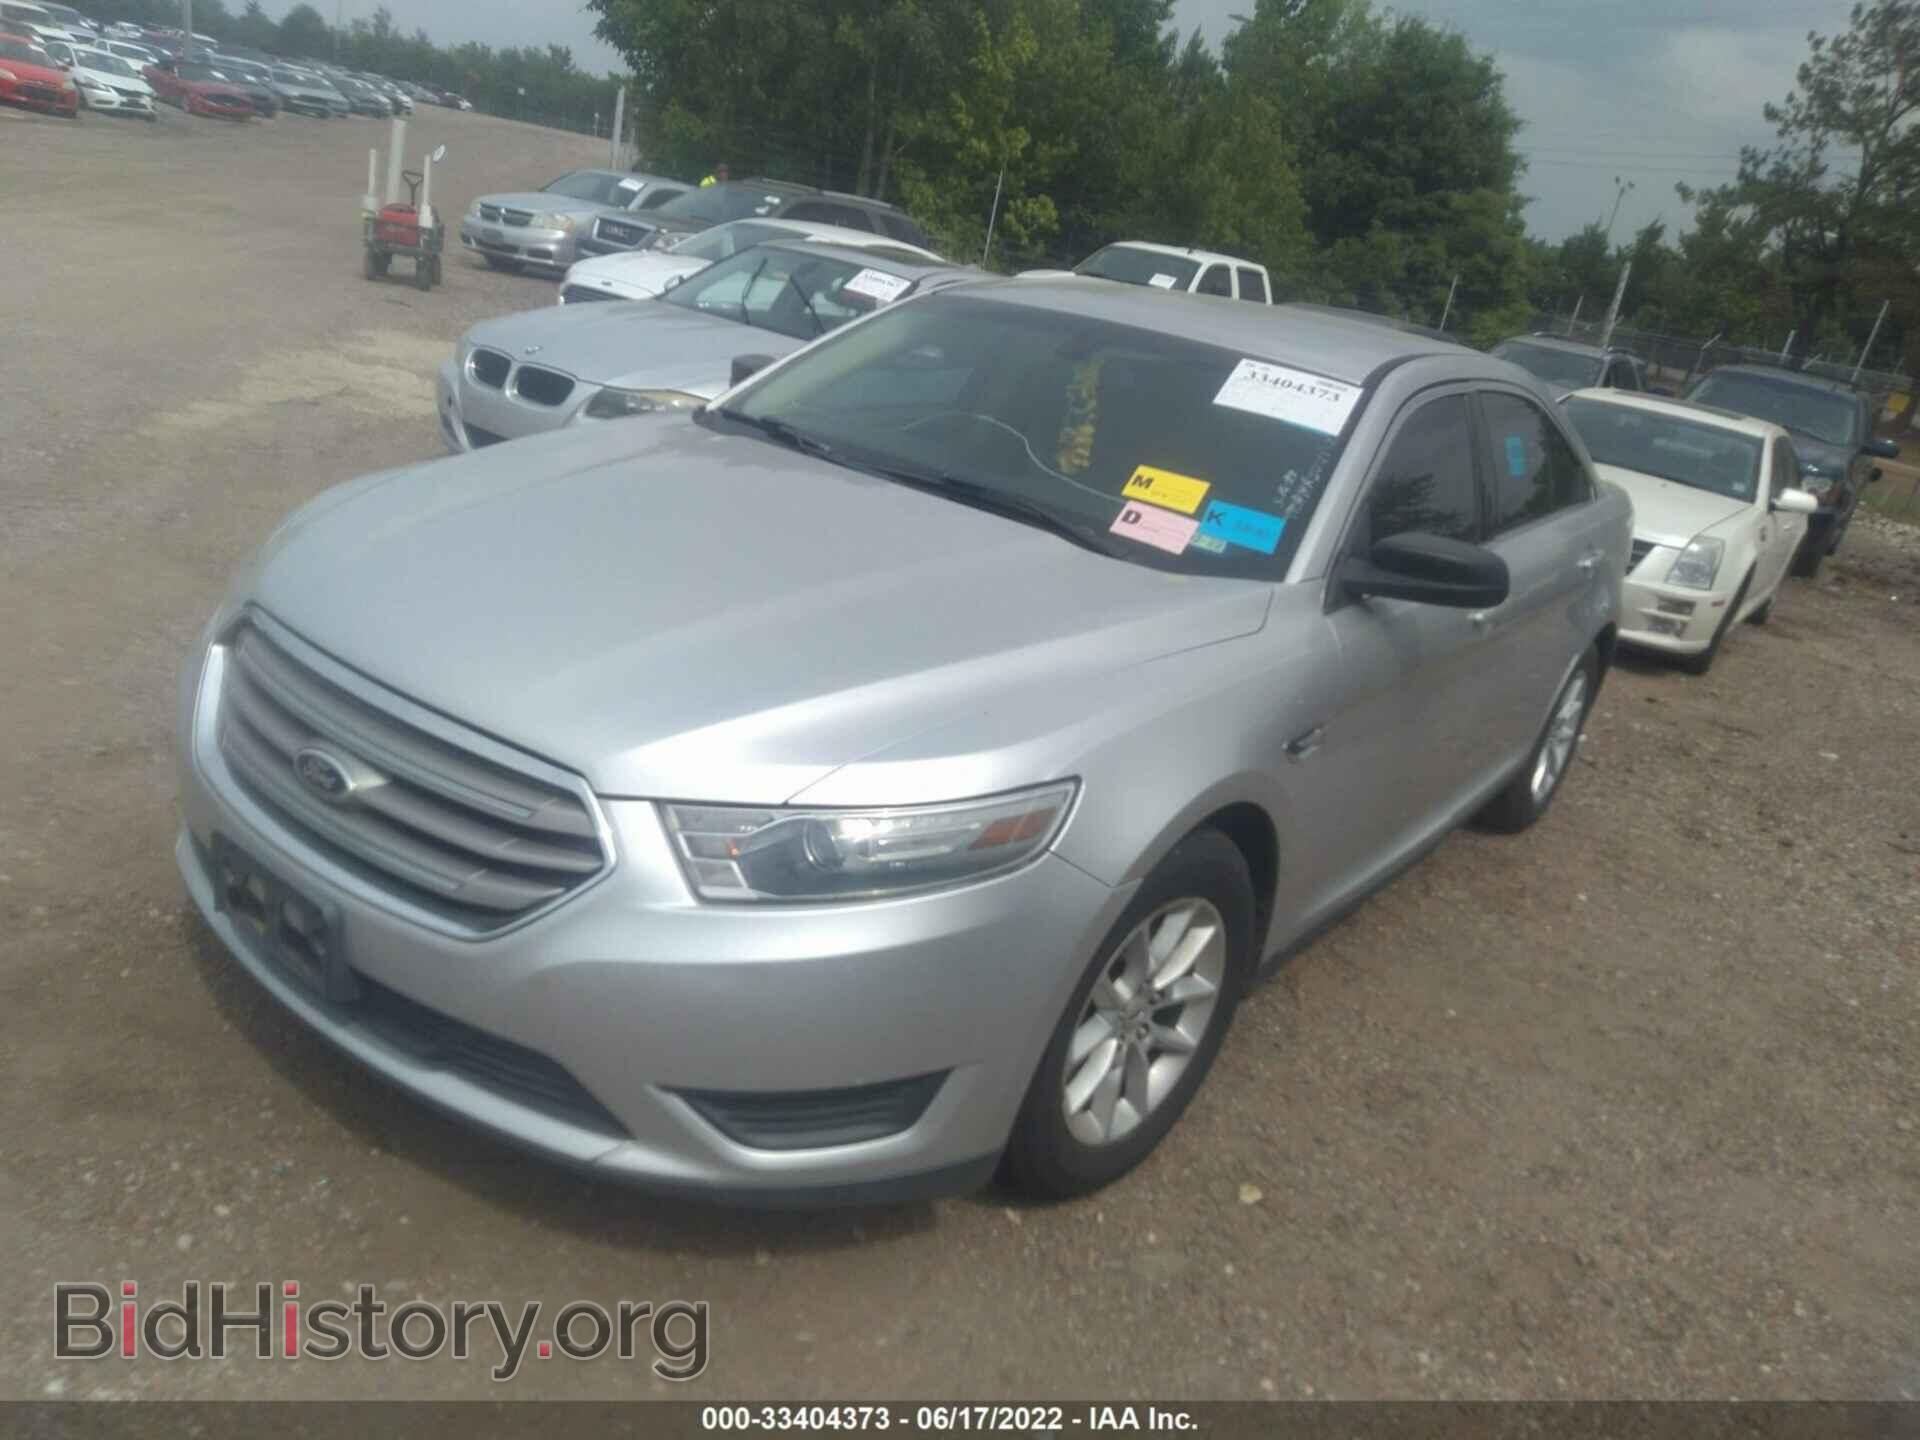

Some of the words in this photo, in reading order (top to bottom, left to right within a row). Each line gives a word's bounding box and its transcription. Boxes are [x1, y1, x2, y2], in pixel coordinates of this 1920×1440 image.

[1131, 474, 1154, 490] M
[1121, 509, 1142, 525] D
[1207, 508, 1227, 527] K
